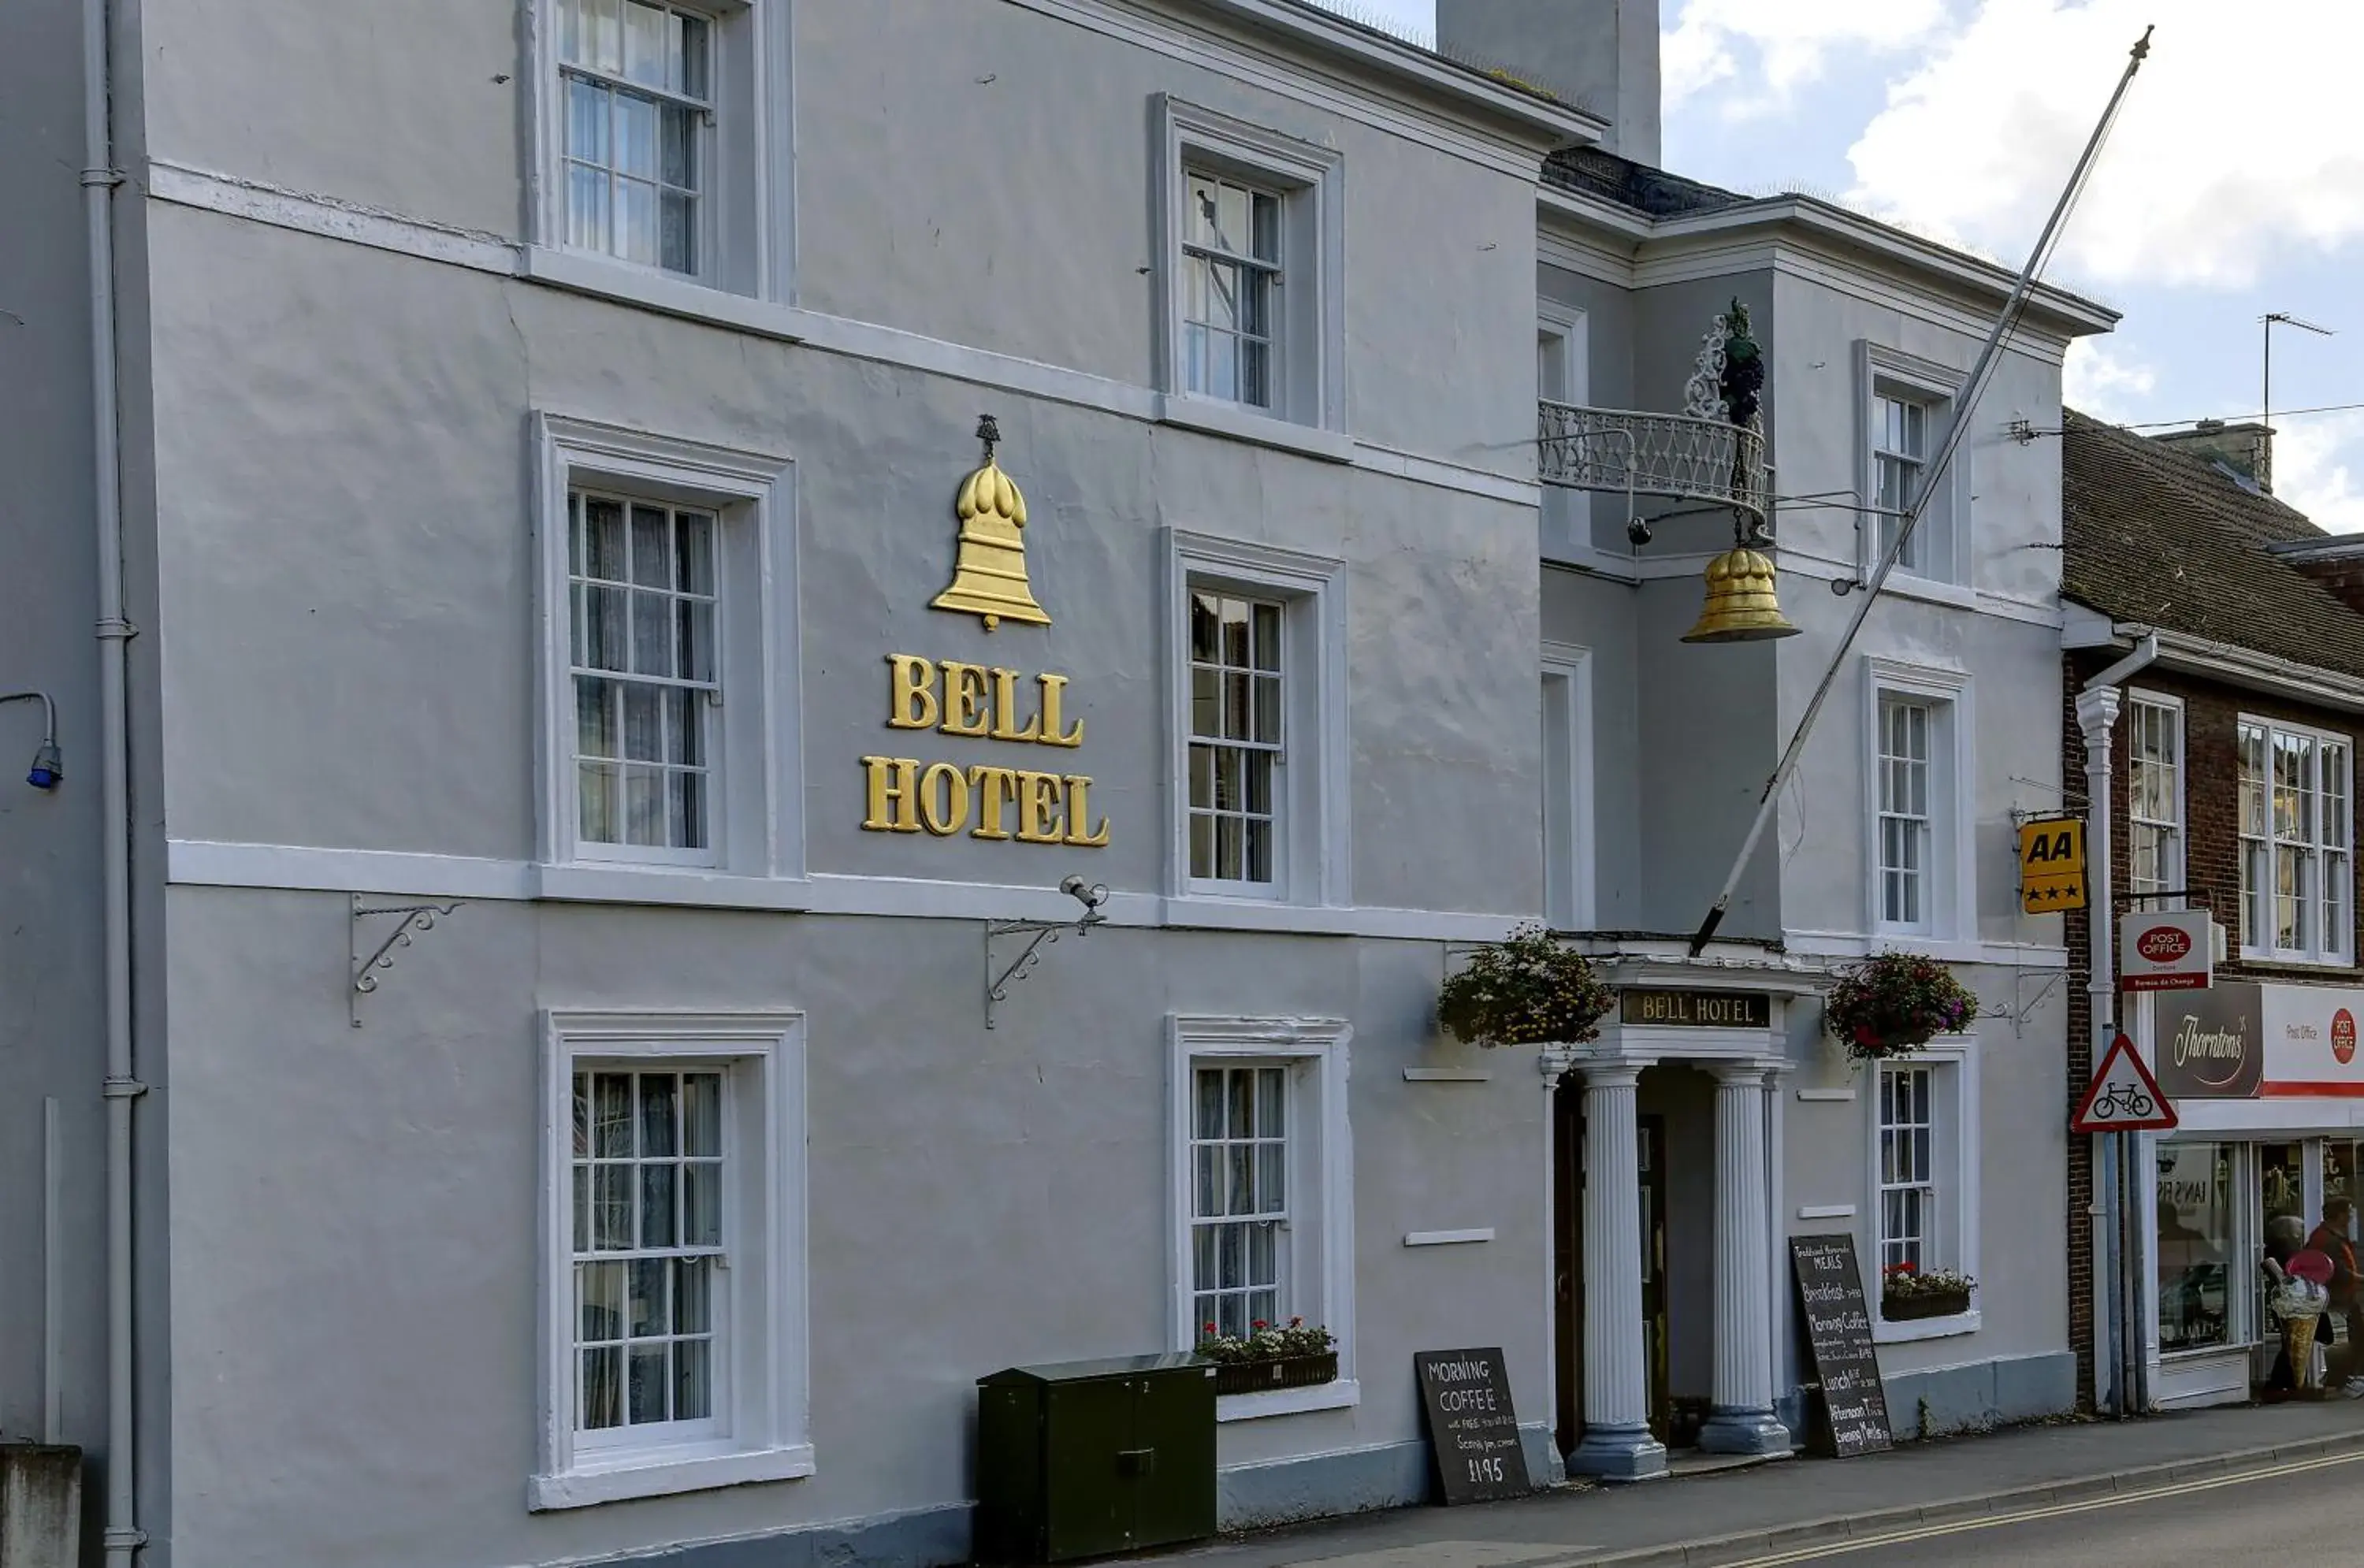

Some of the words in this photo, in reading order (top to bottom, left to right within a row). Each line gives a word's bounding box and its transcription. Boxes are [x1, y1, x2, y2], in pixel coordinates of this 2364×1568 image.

[885, 652, 1084, 748] BELL
[860, 756, 1110, 847] HOTEL
[2027, 831, 2072, 864] AA
[2143, 943, 2186, 954] OFFICE
[2150, 933, 2180, 944] POST
[1642, 996, 1688, 1020] BELL
[1697, 998, 1753, 1022] HOTEL
[2336, 1020, 2351, 1034] POST
[2175, 1014, 2243, 1067] Thorntons
[2334, 1036, 2354, 1050] OFFICE
[1813, 1254, 1843, 1269] MEALS
[1428, 1360, 1489, 1381] MORNING
[1440, 1388, 1497, 1411] COFFEE
